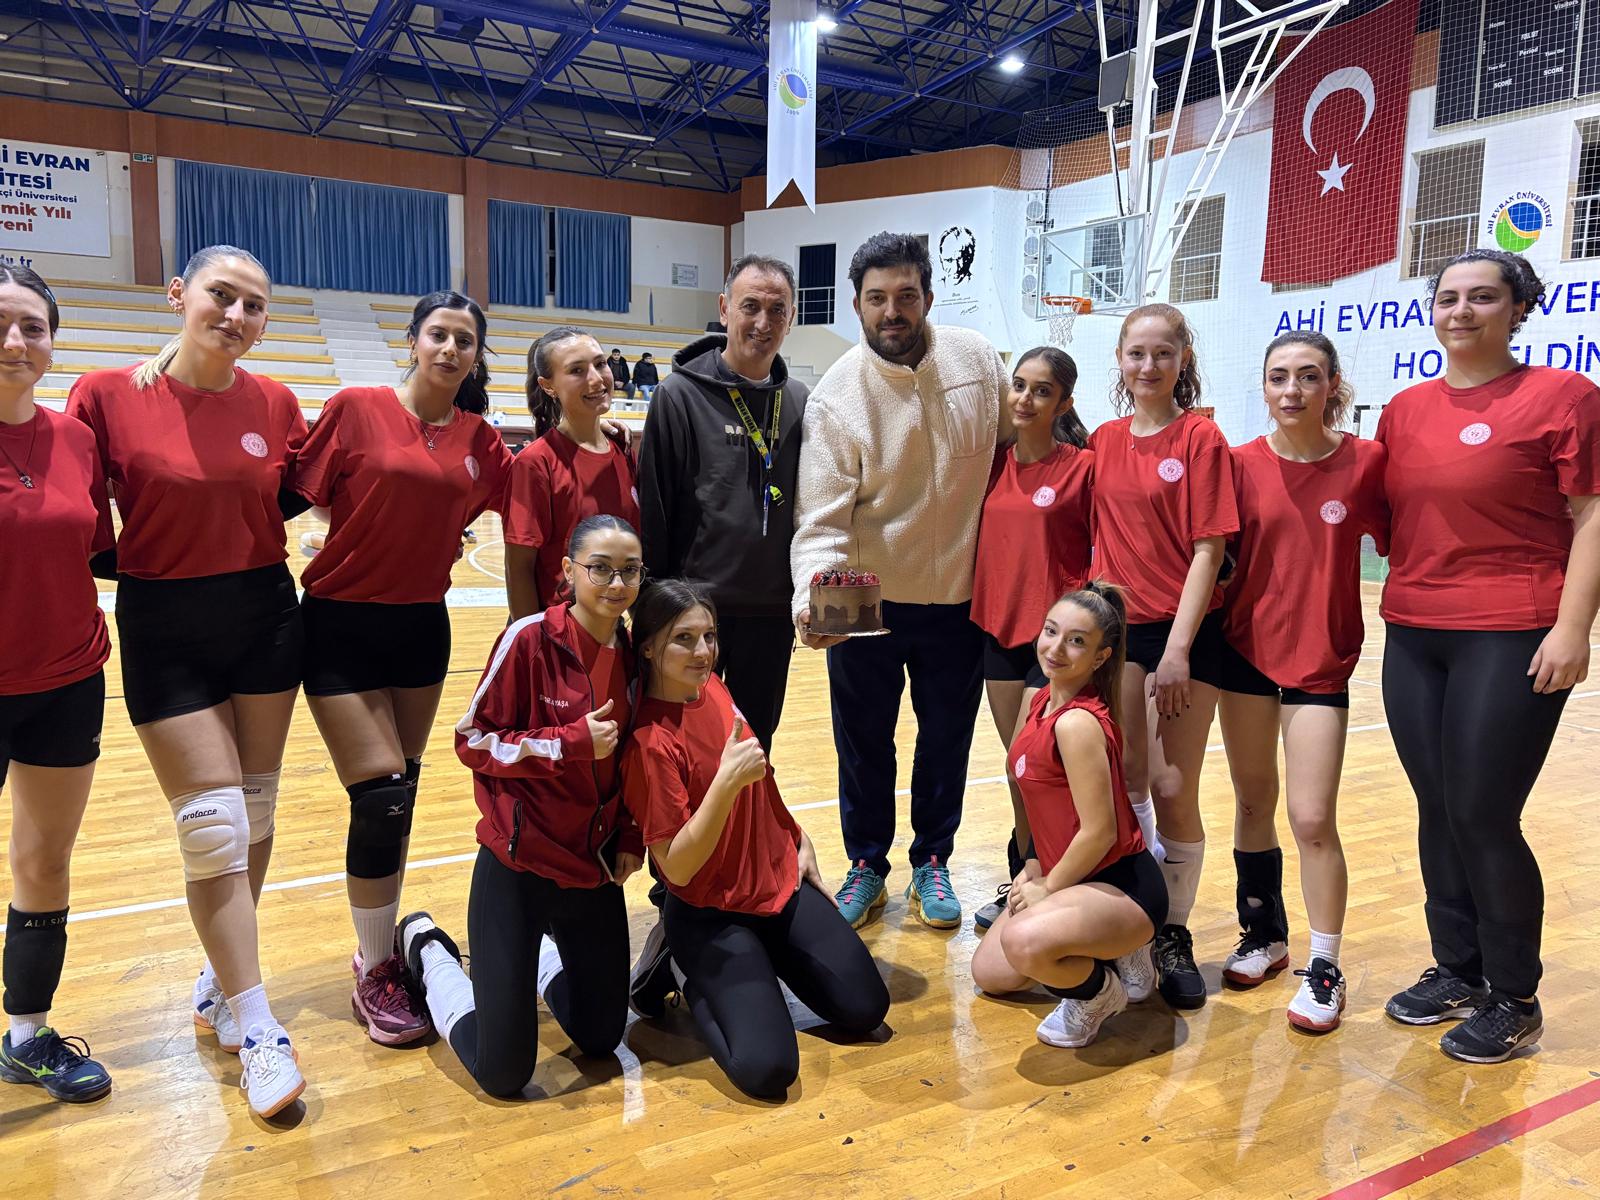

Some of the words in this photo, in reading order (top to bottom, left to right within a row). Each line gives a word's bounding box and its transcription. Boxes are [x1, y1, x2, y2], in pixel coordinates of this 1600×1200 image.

[1554, 0, 1579, 10] Visitors
[1519, 46, 1539, 57] Period
[1543, 66, 1564, 76] SCORE
[1493, 78, 1513, 89] SCORE
[15, 150, 90, 172] EVRAN
[15, 188, 78, 204] Üniversitesi
[1, 202, 38, 217] mik
[42, 205, 72, 220] Yılı
[1491, 195, 1515, 219] EVRAN
[1516, 191, 1553, 228] ÜNİVERSİTESİ
[1274, 300, 1326, 337] AHİ
[1336, 299, 1434, 333] EVRA
[1393, 350, 1443, 380] HO
[182, 807, 218, 822] proforce
